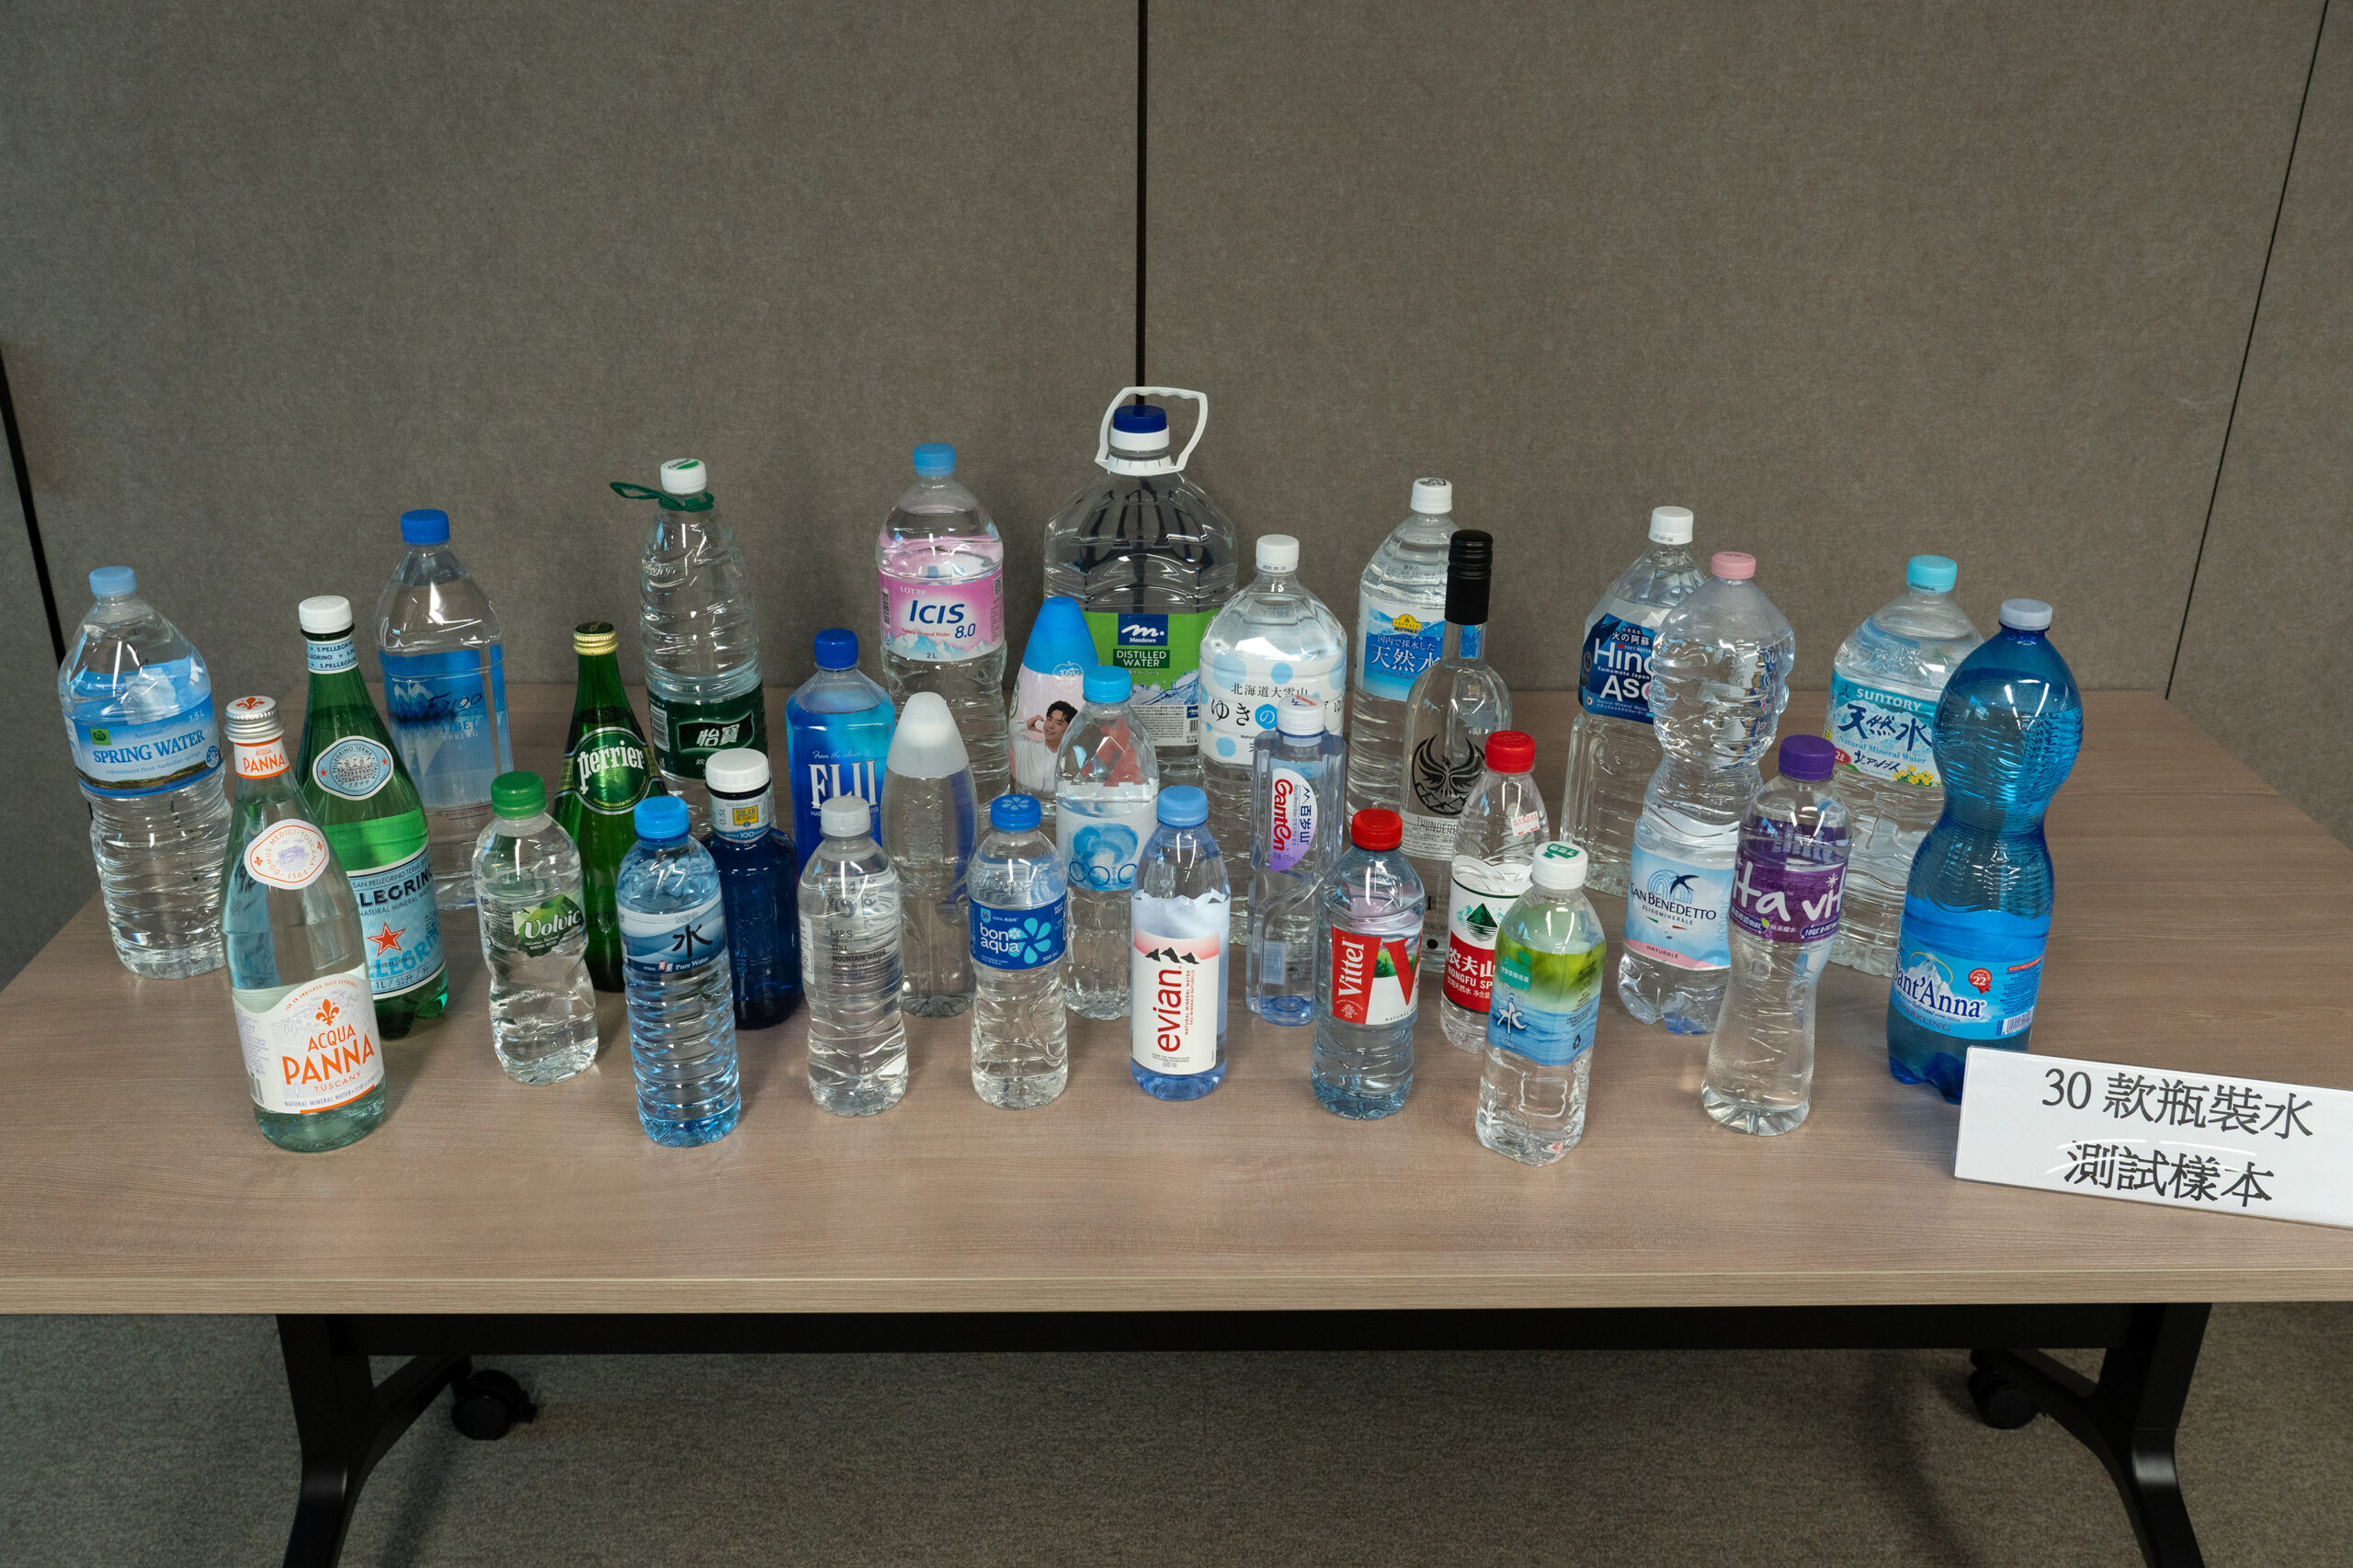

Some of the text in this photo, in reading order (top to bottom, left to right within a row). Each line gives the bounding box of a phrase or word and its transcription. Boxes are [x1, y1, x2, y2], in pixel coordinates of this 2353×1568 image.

[900, 585, 927, 596] LOTTE
[954, 622, 976, 639] 8.0
[1612, 632, 1650, 646] 火の阿蘇
[1117, 650, 1166, 659] DISTILLED
[1123, 659, 1160, 667] WATER
[1370, 644, 1441, 673] 天然水
[1597, 666, 1650, 680] Kumamoto Japan
[1231, 683, 1309, 698] 北海道大雪山
[1857, 688, 1922, 711] SUNTORY
[1211, 699, 1275, 726] ゆきの
[696, 723, 741, 747] 怡寶
[1837, 703, 1932, 752] 天然水
[93, 730, 205, 764] SPRING WATER
[255, 748, 272, 756] ACQUA
[1838, 735, 1927, 764] Natural Mineral Water
[243, 754, 286, 773] PANNA
[1854, 750, 1901, 772] 北アルプス
[1300, 805, 1312, 843] 百岁山
[270, 830, 297, 846] MEDICI
[301, 831, 316, 866] TOSCANA
[288, 869, 309, 880] 1564
[352, 881, 368, 889] SAN
[369, 870, 405, 887] PELLEGRINO
[392, 896, 418, 910] MINERAL
[1631, 882, 1647, 903] SAN
[1648, 892, 1717, 920] BENEDETTO
[525, 910, 580, 938] Volvic
[1643, 904, 1694, 926] OLIGOMINERALE
[672, 924, 713, 959] 水
[830, 929, 853, 938] M&S
[980, 922, 1008, 941] bon
[866, 949, 886, 960] WATER
[981, 937, 1019, 954] aqua
[1646, 945, 1679, 959] NATURALE
[676, 962, 691, 971] Pure
[691, 957, 710, 968] Water
[1338, 939, 1364, 996] Vittel
[1449, 947, 1495, 977] 农夫山
[1448, 965, 1476, 986] NONGFU
[1972, 976, 1986, 986] 22
[1894, 959, 1981, 1017] Sant'Anna
[1153, 970, 1182, 1052] evian
[1497, 1001, 1528, 1034] 水
[1897, 1000, 1951, 1032] SPARKLING
[308, 1023, 356, 1052] ACQUA
[281, 1033, 375, 1085] PANNA
[313, 1071, 361, 1093] TUSCANY
[309, 1096, 334, 1107] MINERAL
[335, 1091, 351, 1101] WATER
[2041, 1068, 2314, 1140] 30 款瓶裝水
[2063, 1140, 2274, 1208] 測試樣本
